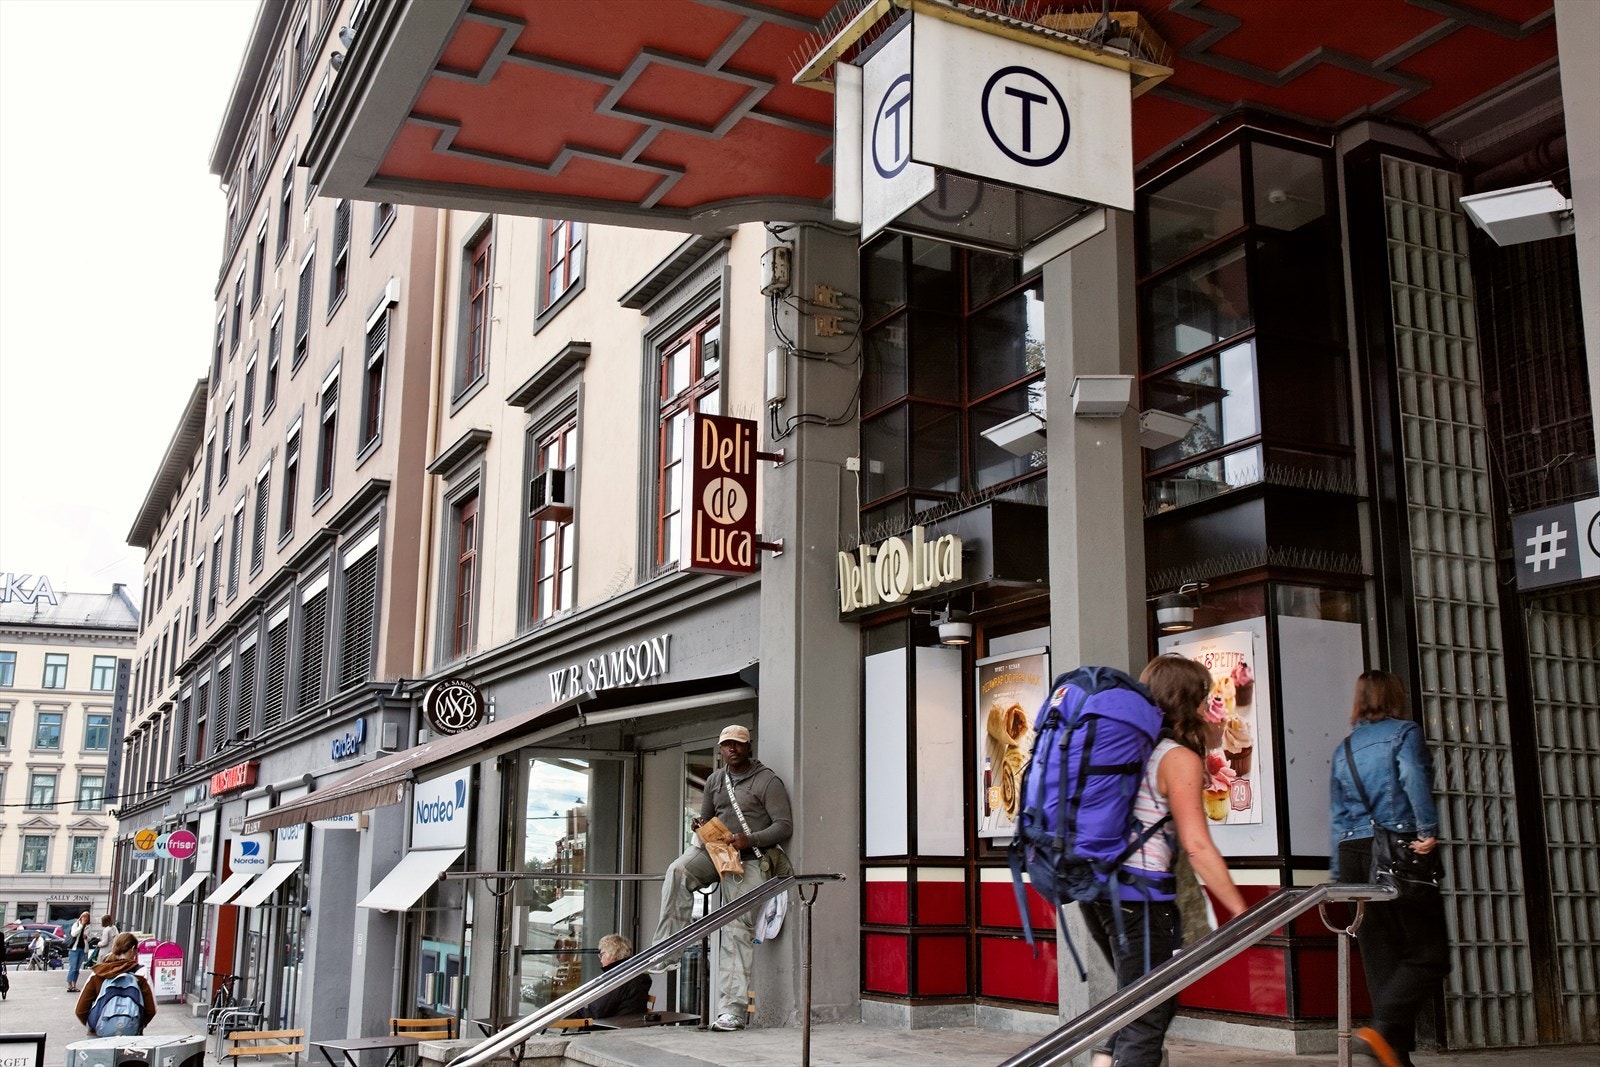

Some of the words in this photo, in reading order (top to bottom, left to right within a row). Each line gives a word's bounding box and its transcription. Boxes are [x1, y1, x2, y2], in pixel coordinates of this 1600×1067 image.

[1004, 86, 1048, 153] T
[701, 418, 750, 475] Deli
[711, 477, 738, 522] de
[696, 509, 752, 567] Luca
[838, 544, 878, 613] Deli
[912, 525, 960, 591] Luca
[0, 572, 58, 606] KA
[586, 633, 671, 692] SAMSON
[1214, 651, 1245, 668] PETITE
[451, 680, 477, 694] SAMSON
[108, 661, 127, 801] KONTAKTLINSER
[331, 732, 359, 760] Nordea
[1234, 784, 1246, 802] 29
[416, 795, 454, 825] Nordea
[134, 851, 157, 859] apotek
[168, 839, 196, 850] frisør
[233, 857, 265, 865] Nordea
